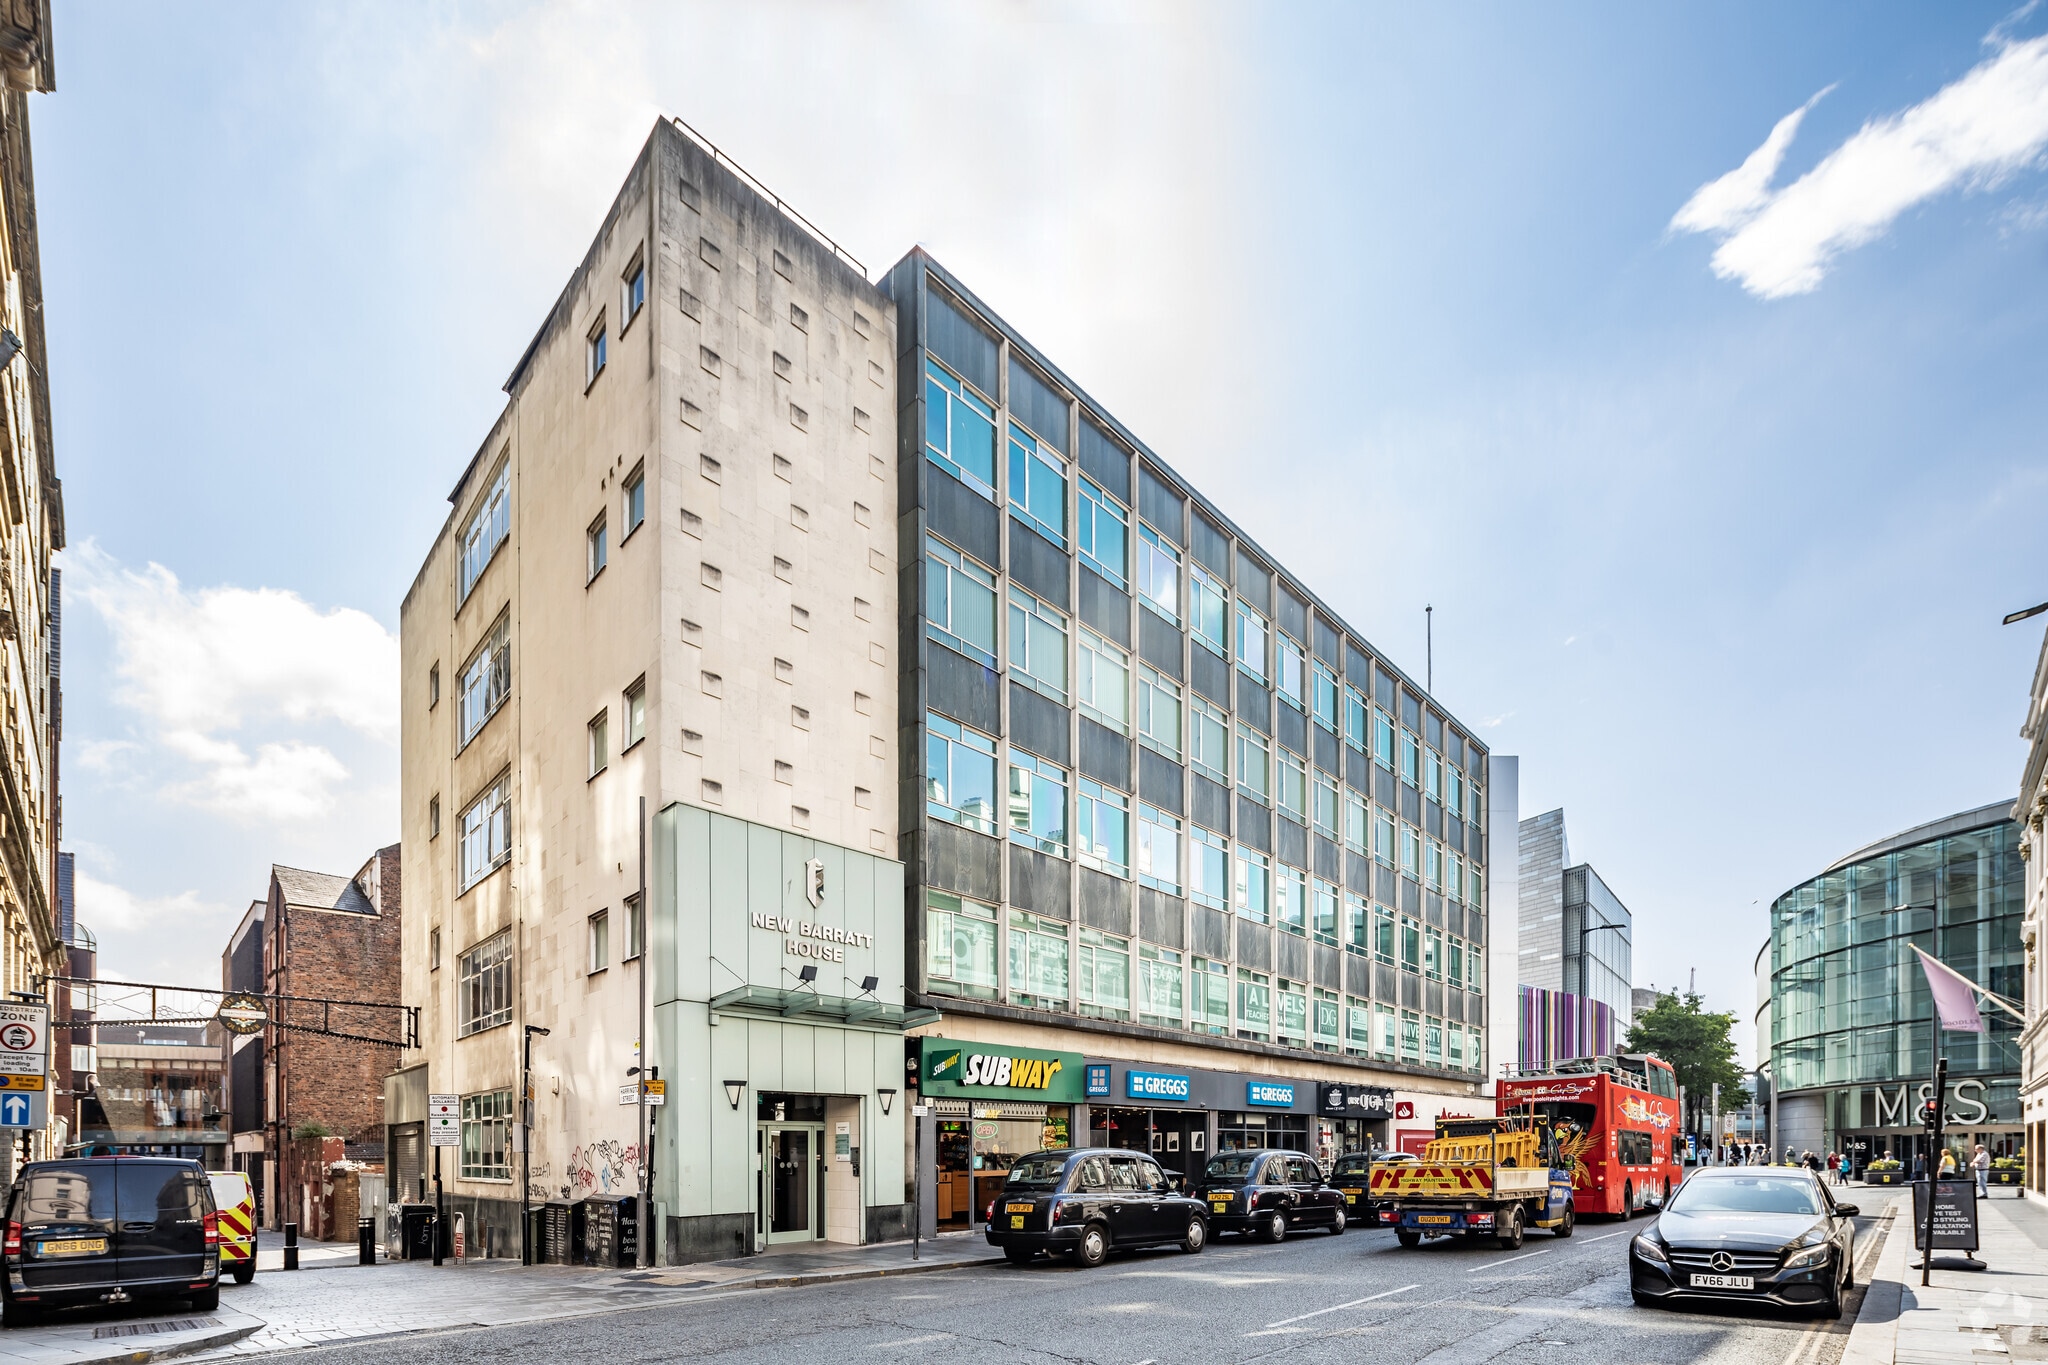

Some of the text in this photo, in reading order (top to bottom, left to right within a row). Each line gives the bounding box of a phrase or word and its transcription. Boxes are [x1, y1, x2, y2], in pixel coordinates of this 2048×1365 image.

[752, 912, 873, 948] NEW BARRATT
[786, 939, 843, 963] HOUSE
[1152, 965, 1182, 984] EXAM
[0, 1006, 45, 1014] EDESTRIAN
[1249, 987, 1306, 1016] A LVELS
[0, 1012, 36, 1022] ZONE
[1321, 1006, 1337, 1027] DG
[933, 1053, 960, 1076] SUBWAY
[963, 1054, 1063, 1089] SUBWAY
[621, 1086, 638, 1094] HARRINGT
[1145, 1077, 1188, 1096] GREGGS
[1261, 1086, 1293, 1103] GREGGS
[1874, 1080, 1989, 1128] M&S
[973, 1109, 1001, 1119] SUBWAY
[976, 1125, 995, 1135] OPEN
[1846, 1142, 1867, 1150] M&S
[47, 1240, 103, 1252] GN66 ONG
[1695, 1275, 1749, 1287] FV66 JLU
